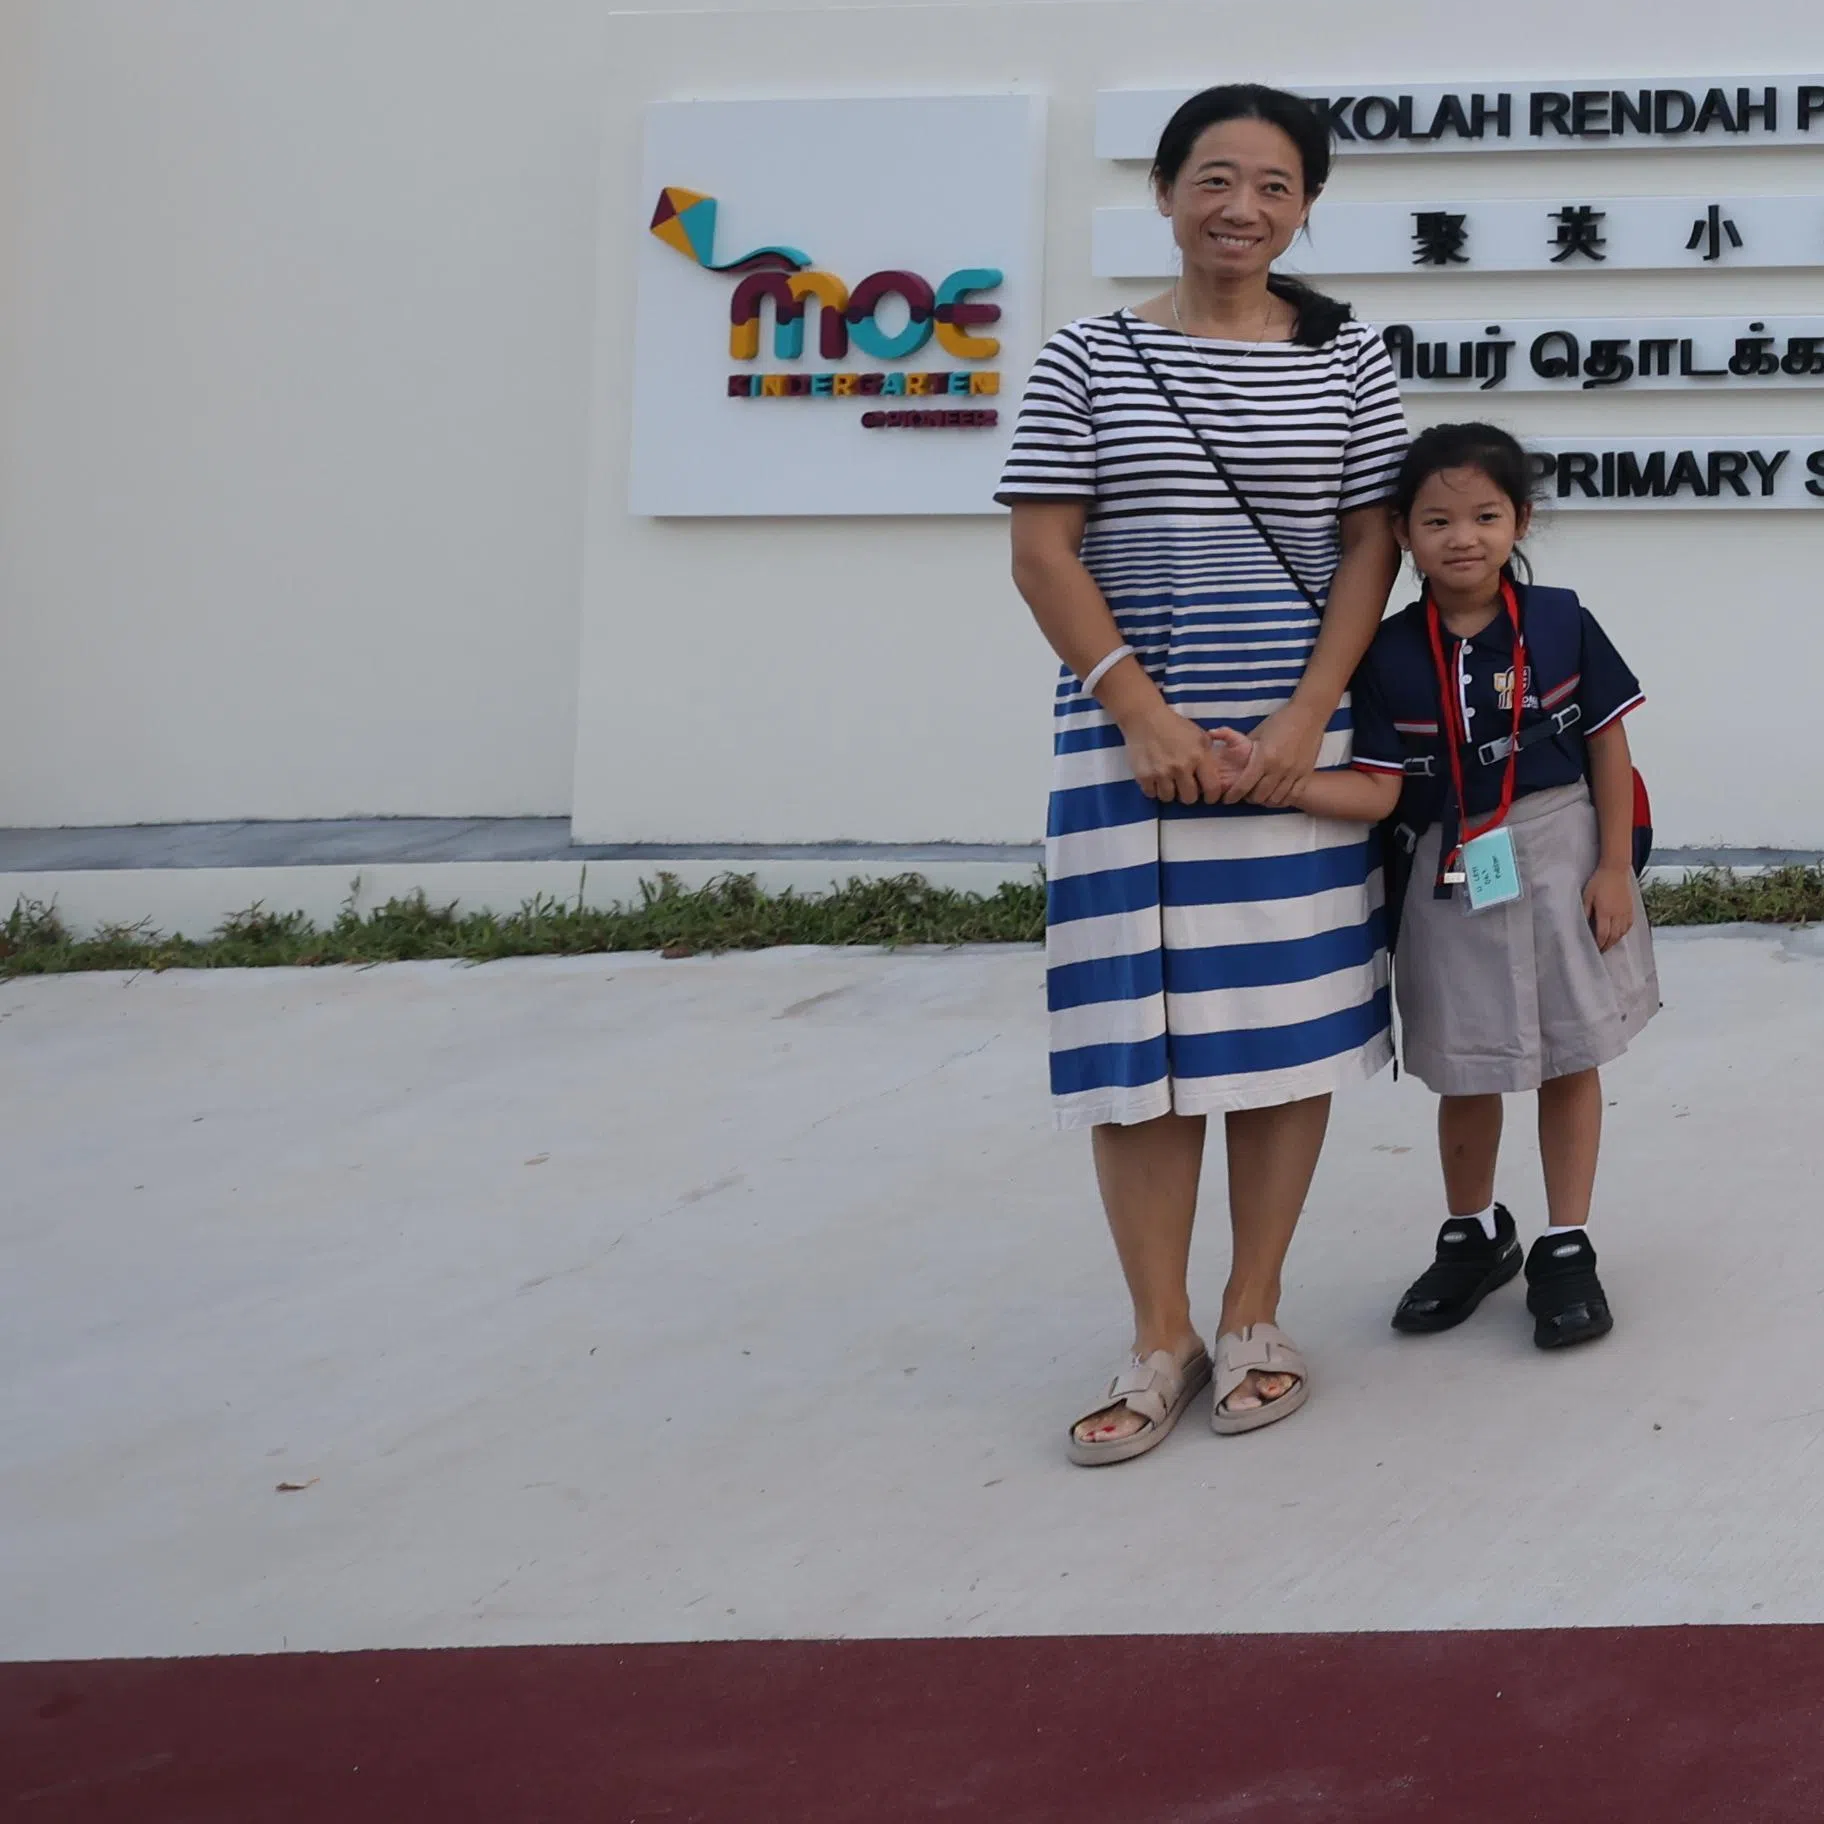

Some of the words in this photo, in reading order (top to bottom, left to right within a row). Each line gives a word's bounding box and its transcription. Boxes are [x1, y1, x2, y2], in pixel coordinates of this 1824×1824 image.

[1312, 93, 1512, 143] KOLAH
[1529, 86, 1777, 138] RENDAH
[727, 372, 1001, 397] KINDERGARTEN
